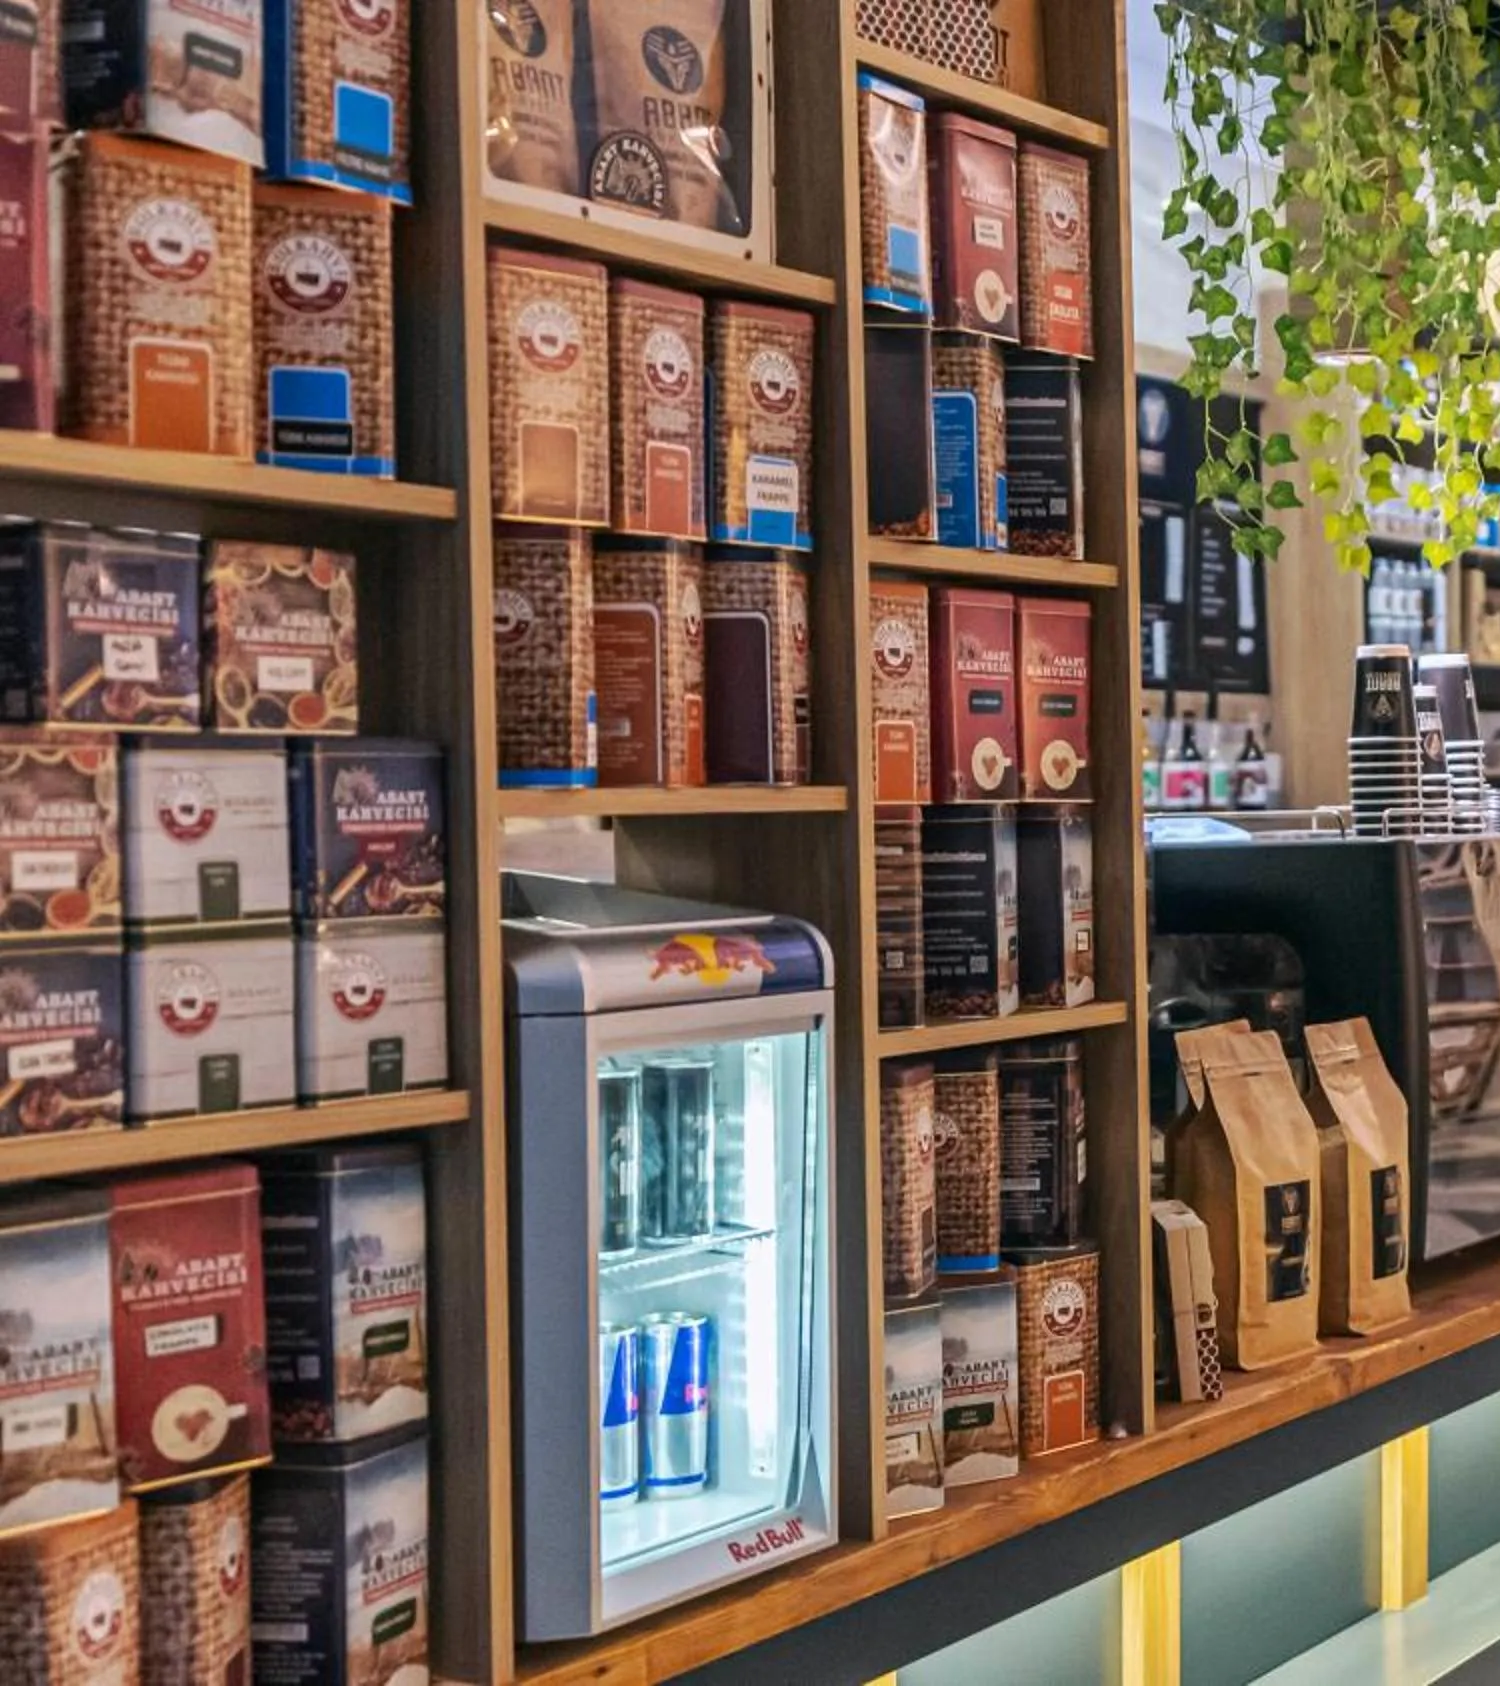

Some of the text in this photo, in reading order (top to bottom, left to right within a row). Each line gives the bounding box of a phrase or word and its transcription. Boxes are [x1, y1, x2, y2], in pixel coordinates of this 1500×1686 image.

[490, 56, 564, 105] ABANT
[642, 95, 717, 131] ABAN
[594, 142, 619, 194] ABANT
[116, 589, 177, 608] ABANT
[281, 611, 331, 630] ABANT
[1053, 656, 1086, 666] ABANT
[376, 790, 427, 804] ABANT
[36, 802, 98, 819] ABANT
[0, 819, 100, 837] AHVECİSİ
[36, 989, 99, 1010] ABANT
[0, 1006, 102, 1030] AHVECİSİ
[175, 1252, 246, 1277] ABANT
[383, 1262, 421, 1281] ABANT
[32, 1336, 98, 1361] ABANT
[965, 1360, 1006, 1374] ABANT
[892, 1386, 933, 1402] ABANT
